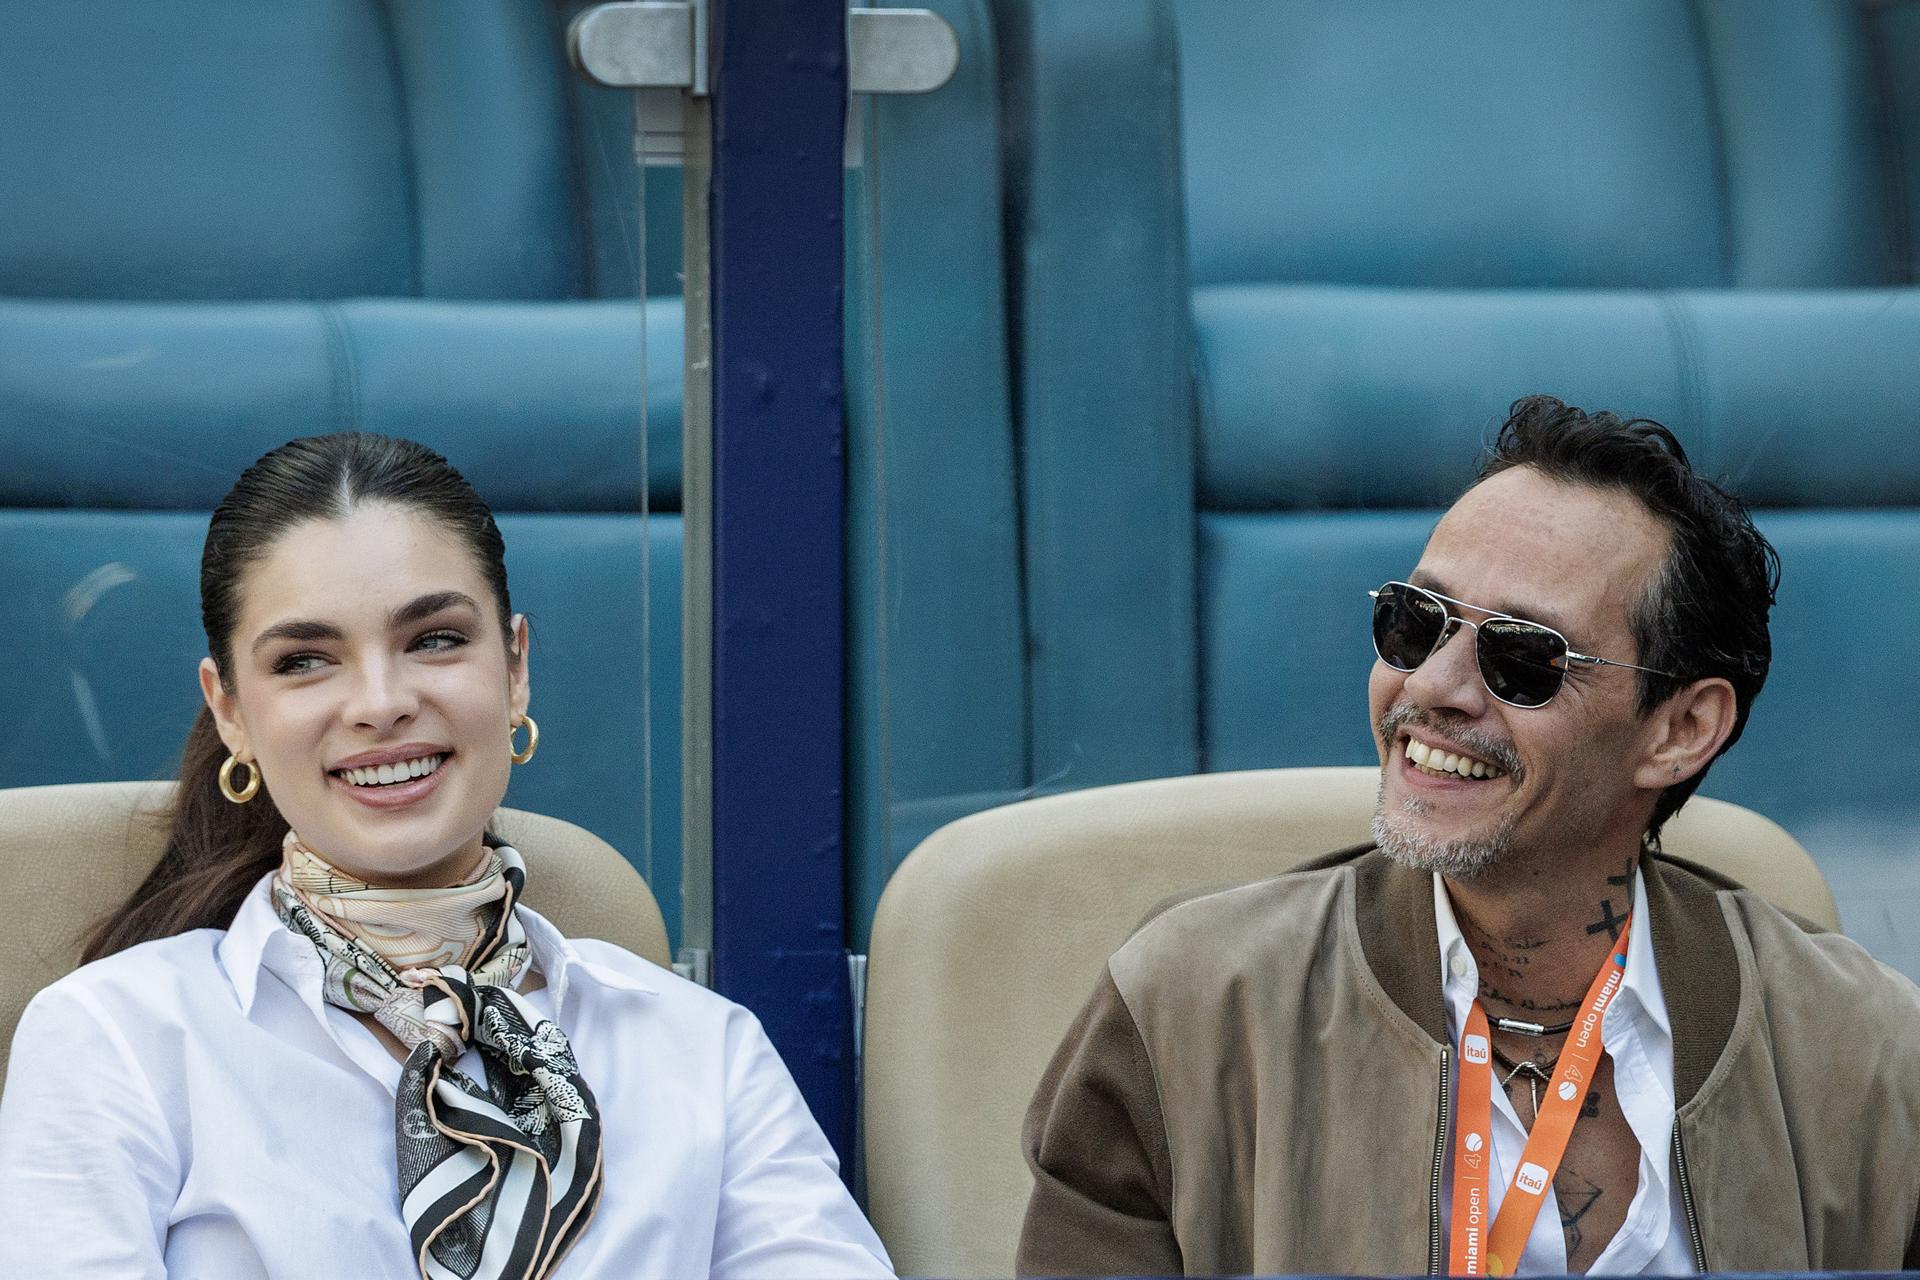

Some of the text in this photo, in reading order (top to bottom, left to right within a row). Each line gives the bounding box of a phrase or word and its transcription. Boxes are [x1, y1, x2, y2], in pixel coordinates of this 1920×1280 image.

[1592, 970, 1622, 1013] miami
[1576, 1013, 1597, 1048] open
[1469, 1187, 1482, 1224] open
[1465, 1227, 1479, 1275] miami
